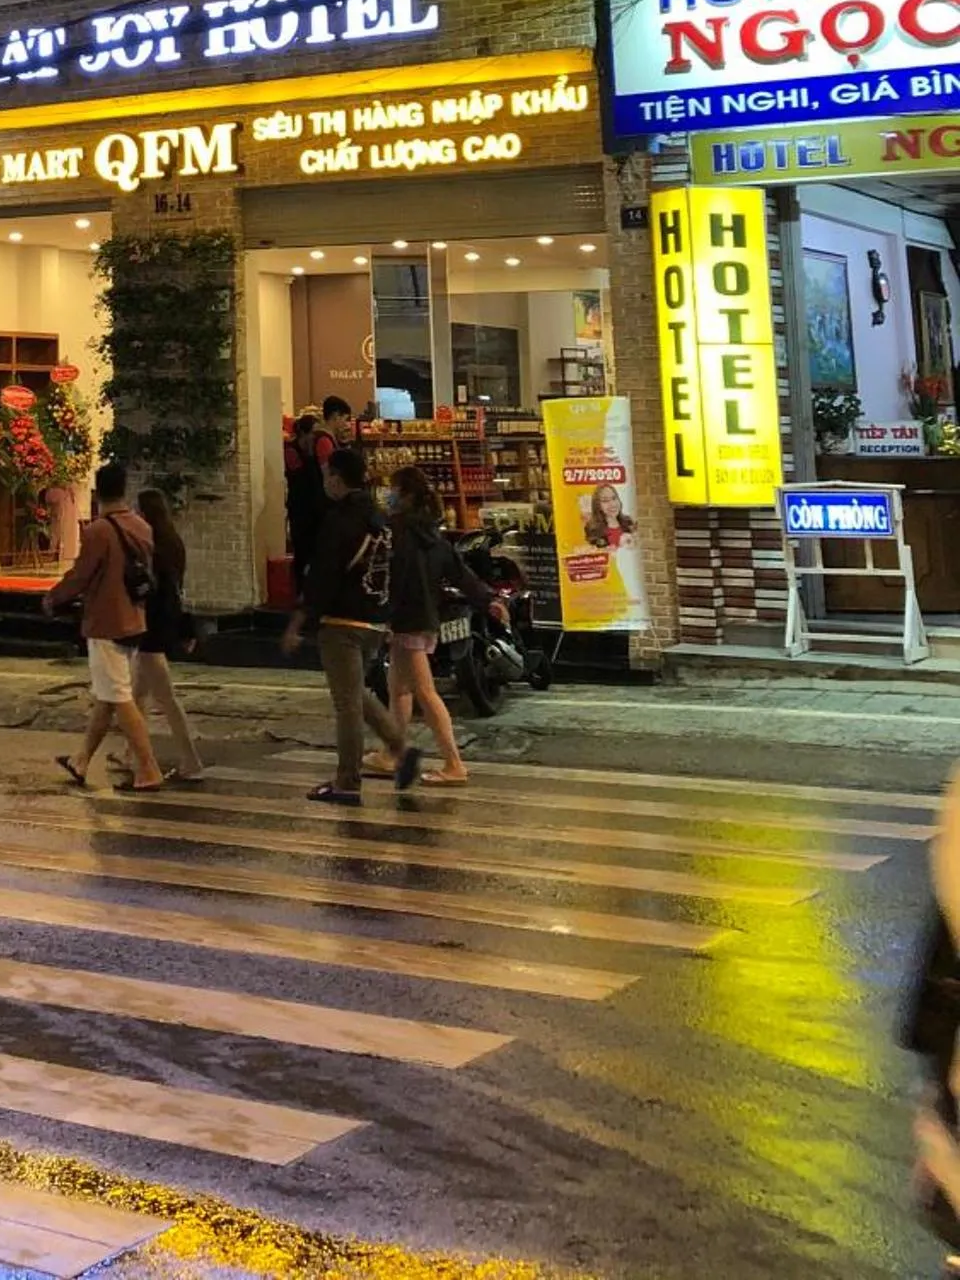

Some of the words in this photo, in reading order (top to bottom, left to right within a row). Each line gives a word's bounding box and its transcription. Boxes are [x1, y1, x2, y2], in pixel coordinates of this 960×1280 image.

[79, 6, 190, 72] JOY
[253, 110, 302, 141] SIÊU
[308, 109, 347, 137] THỊ
[353, 100, 424, 131] HÀNG
[431, 90, 503, 125] NHẬP
[511, 75, 588, 117] KHẨU
[640, 95, 711, 123] TIỆN
[722, 87, 819, 114] NGHI,
[830, 74, 900, 106] GIÁ
[1, 147, 83, 183] MART
[94, 122, 239, 192] QFM
[300, 138, 362, 174] CHẤT
[370, 138, 457, 171] LƯỢNG
[462, 132, 522, 163] CAO
[711, 134, 852, 177] HOTEL
[659, 208, 695, 480] HOTEL
[708, 211, 757, 437] HOTEL
[859, 444, 920, 454] RECEPTION
[789, 498, 824, 529] CÒN
[826, 498, 888, 530] PHÒNG
